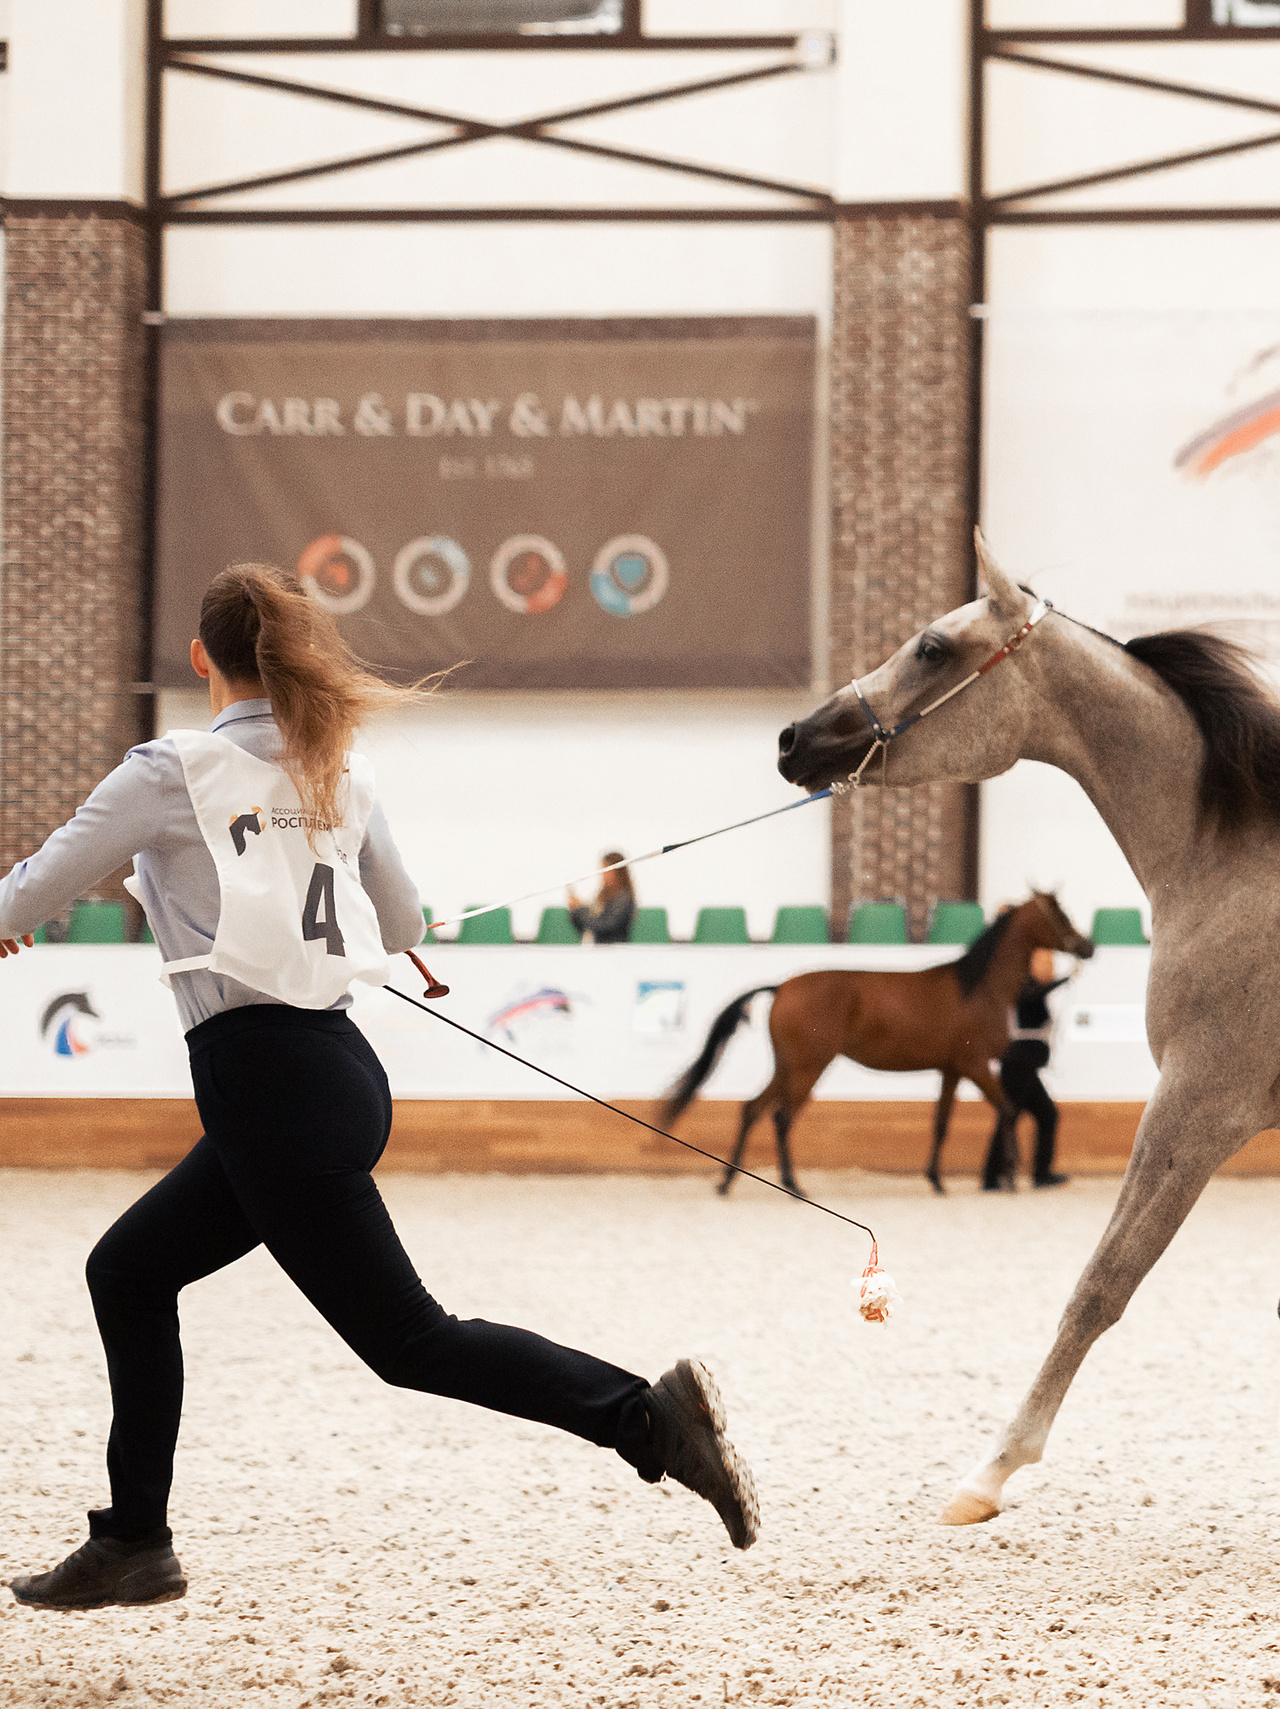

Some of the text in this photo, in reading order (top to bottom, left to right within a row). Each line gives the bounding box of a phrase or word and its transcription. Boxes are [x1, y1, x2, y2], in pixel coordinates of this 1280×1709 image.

[216, 391, 746, 437] CARR & DAY & MARTIN
[302, 862, 346, 957] 4
